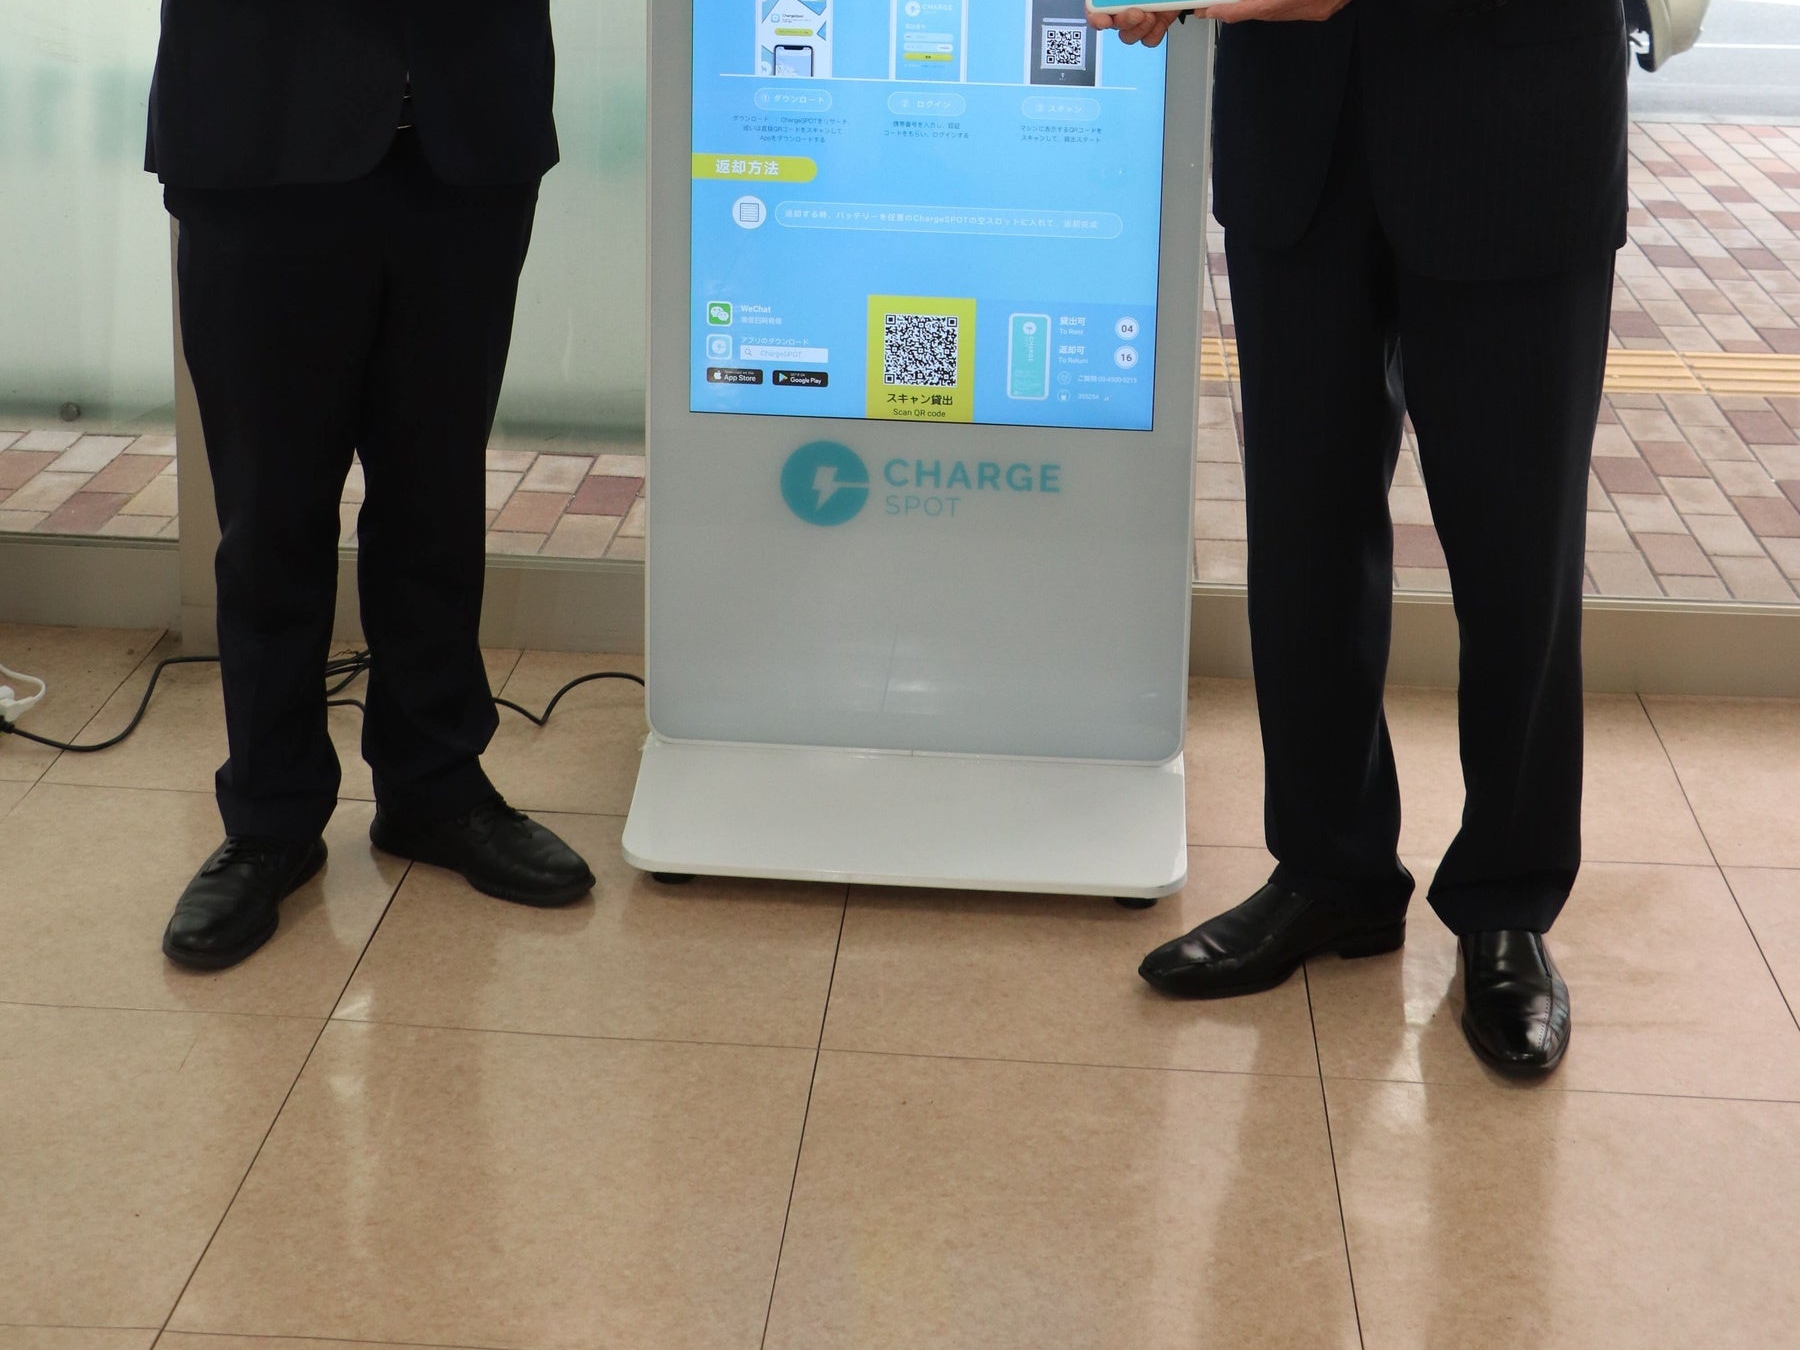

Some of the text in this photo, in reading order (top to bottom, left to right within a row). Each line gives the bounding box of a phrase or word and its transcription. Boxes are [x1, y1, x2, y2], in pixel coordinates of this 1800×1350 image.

[715, 159, 780, 176] 返却方法
[740, 305, 772, 314] WeChat
[1121, 324, 1134, 333] 04
[1120, 354, 1133, 362] 16
[724, 374, 757, 383] App Store
[790, 376, 822, 385] Google Play
[886, 393, 953, 405] スキャン貸出
[893, 408, 946, 418] Scan QR code
[884, 458, 1062, 493] CHARGE
[885, 494, 961, 518] SPOT
